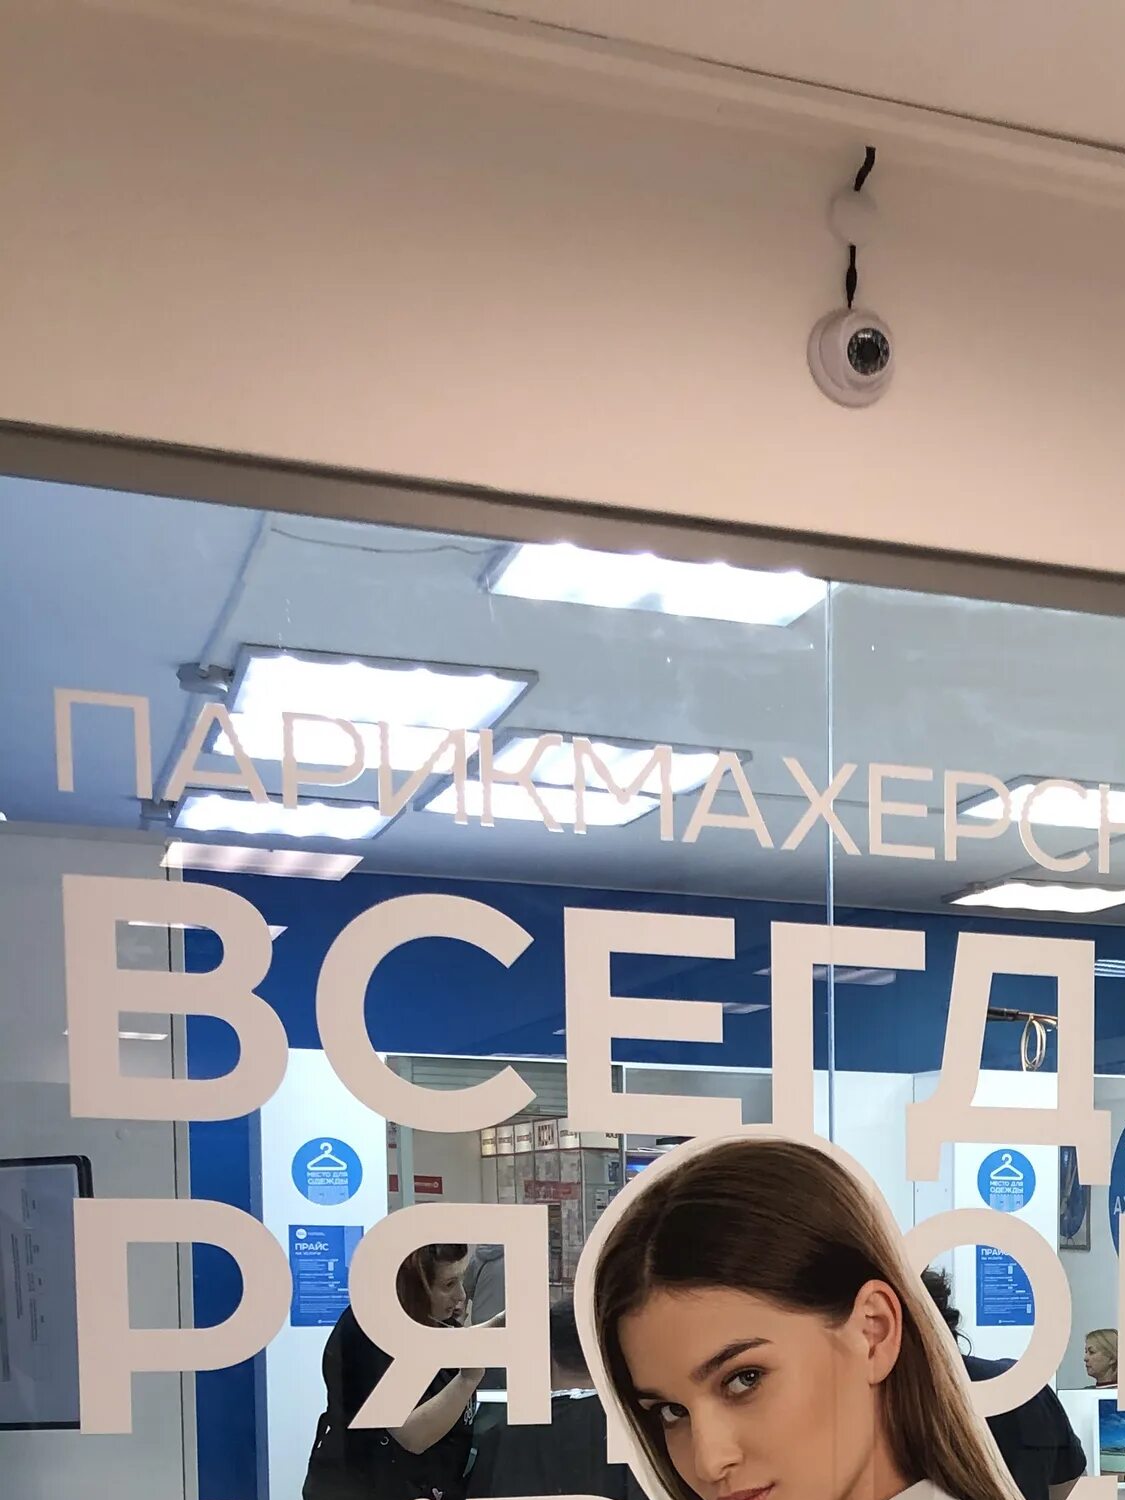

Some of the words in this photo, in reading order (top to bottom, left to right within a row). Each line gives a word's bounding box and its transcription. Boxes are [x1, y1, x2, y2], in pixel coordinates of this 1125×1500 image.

[307, 1178, 349, 1186] ОДЕЖДЫ
[989, 1186, 1024, 1194] ОДЕЖДЫ
[294, 1241, 329, 1251] ПРАЙС
